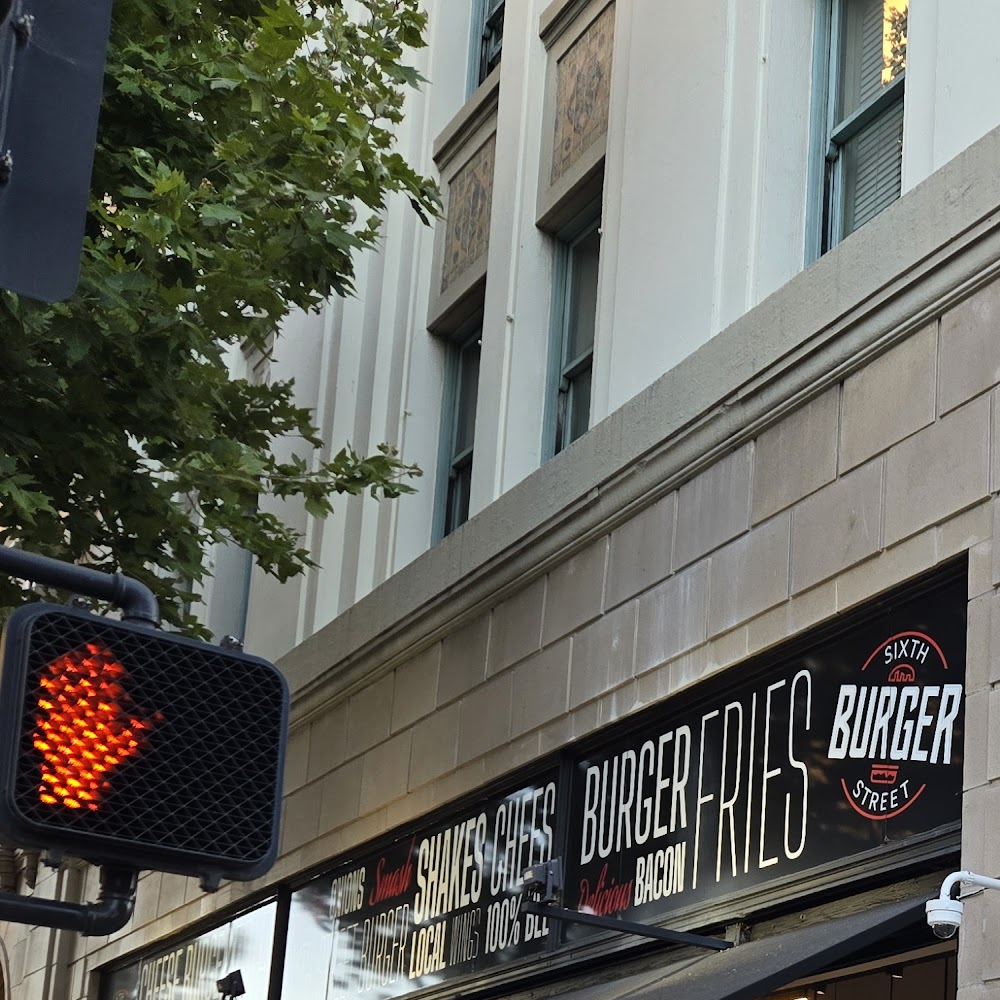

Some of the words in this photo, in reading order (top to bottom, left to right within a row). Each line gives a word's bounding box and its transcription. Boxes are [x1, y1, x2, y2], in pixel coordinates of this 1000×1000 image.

[884, 639, 930, 665] SIXTH
[828, 683, 963, 764] BURGER
[580, 724, 691, 865] BURGER
[692, 669, 812, 890] FRIES
[852, 779, 910, 811] STREET
[330, 867, 366, 919] ONIONS
[368, 834, 416, 906] Smash
[413, 812, 487, 926] SHAKES
[633, 841, 687, 907] BACON
[408, 920, 447, 979] LOCAL
[449, 907, 481, 966] WINGS
[485, 893, 523, 954] 100%
